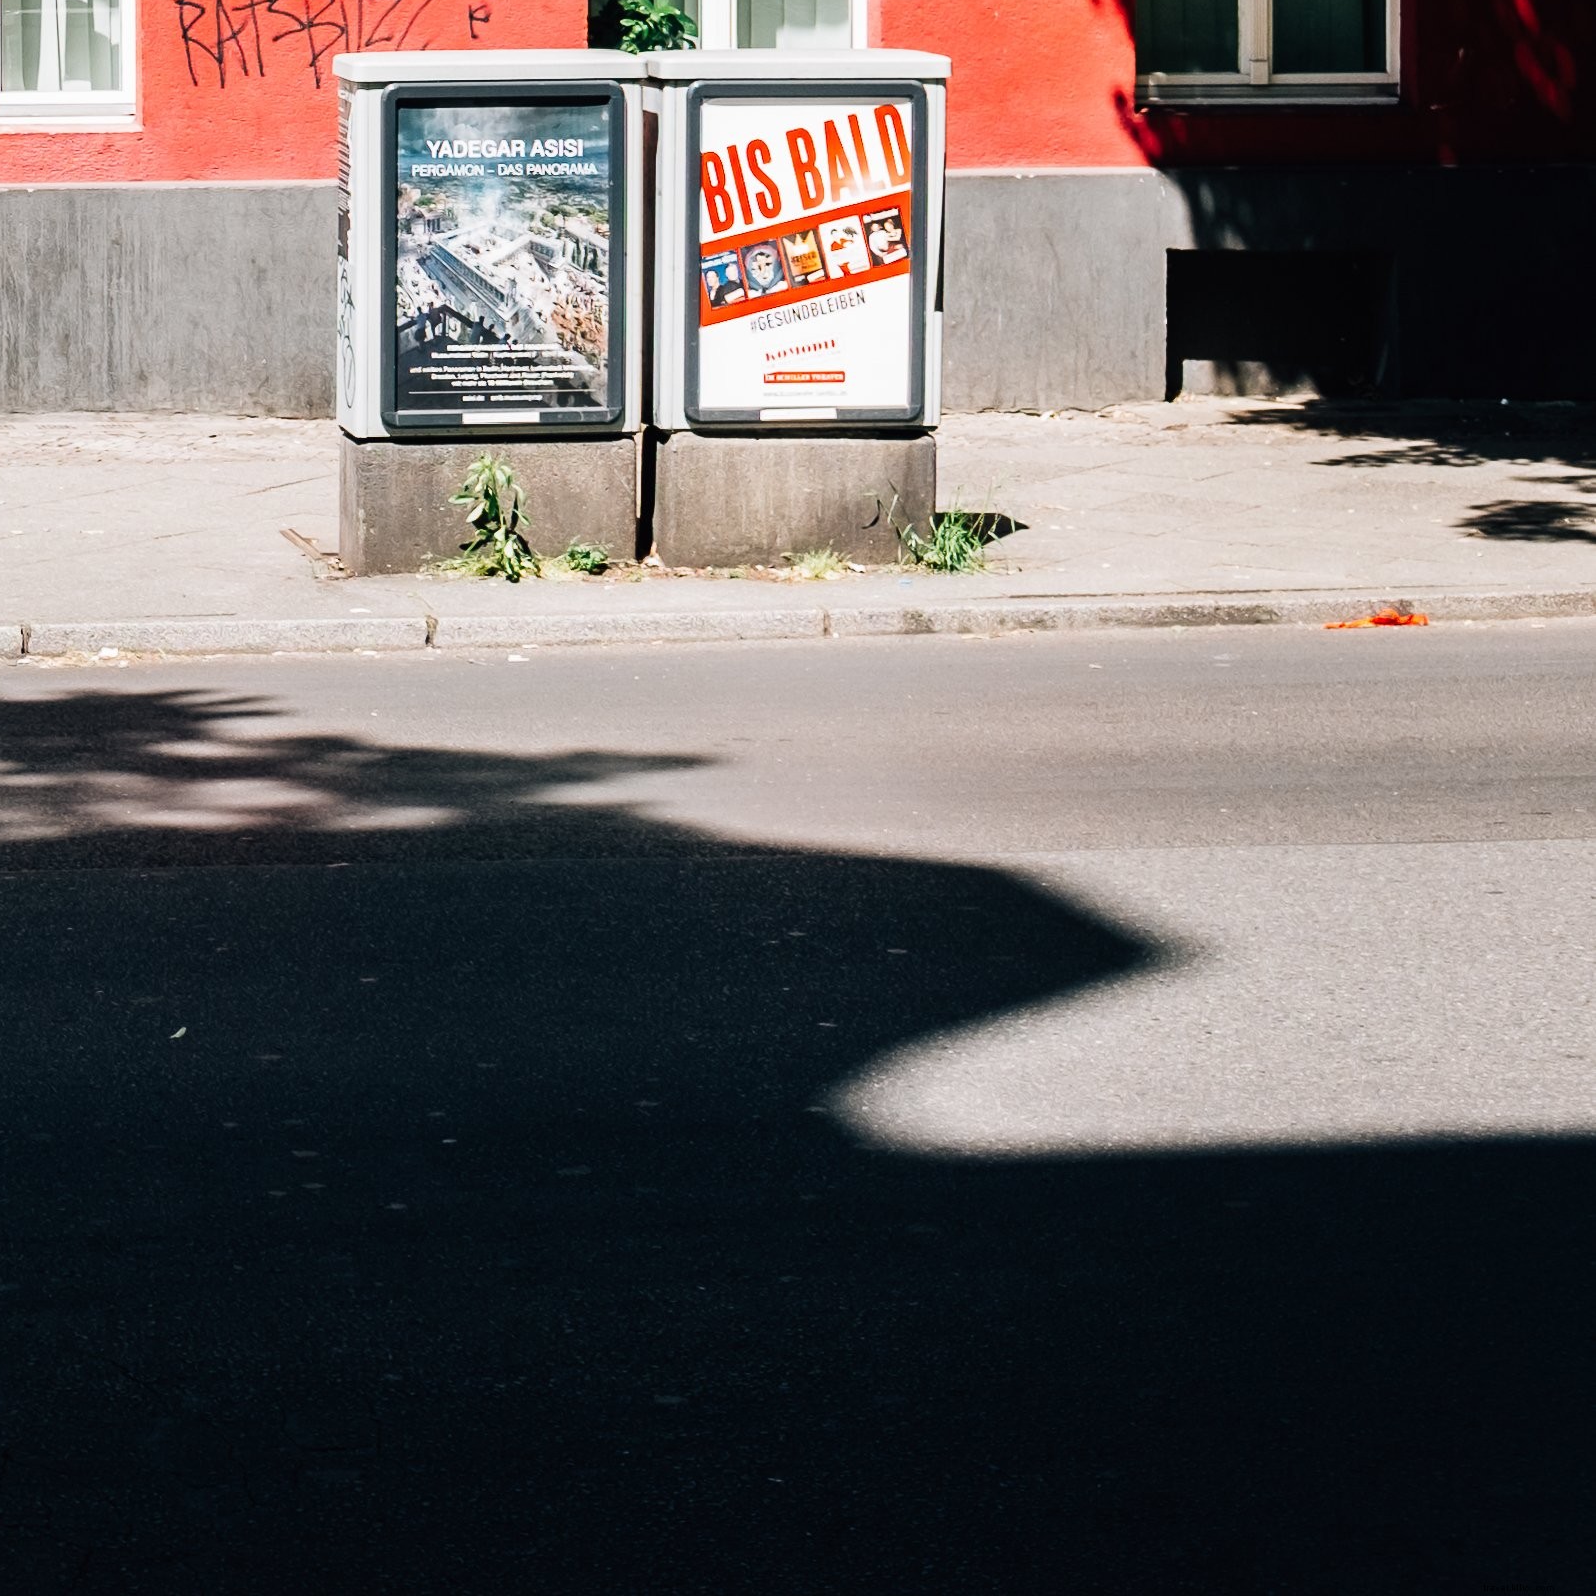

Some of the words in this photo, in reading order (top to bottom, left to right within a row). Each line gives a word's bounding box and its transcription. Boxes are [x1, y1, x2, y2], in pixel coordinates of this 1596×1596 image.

[426, 139, 526, 159] YADEGAR
[530, 138, 584, 158] ASISI
[411, 163, 485, 177] PERGAMON
[498, 163, 524, 177] DAS
[526, 162, 598, 177] PANORAMA
[701, 138, 782, 234] BIS
[786, 103, 911, 211] BALD
[750, 289, 867, 333] #GESUNDBLEIBEN
